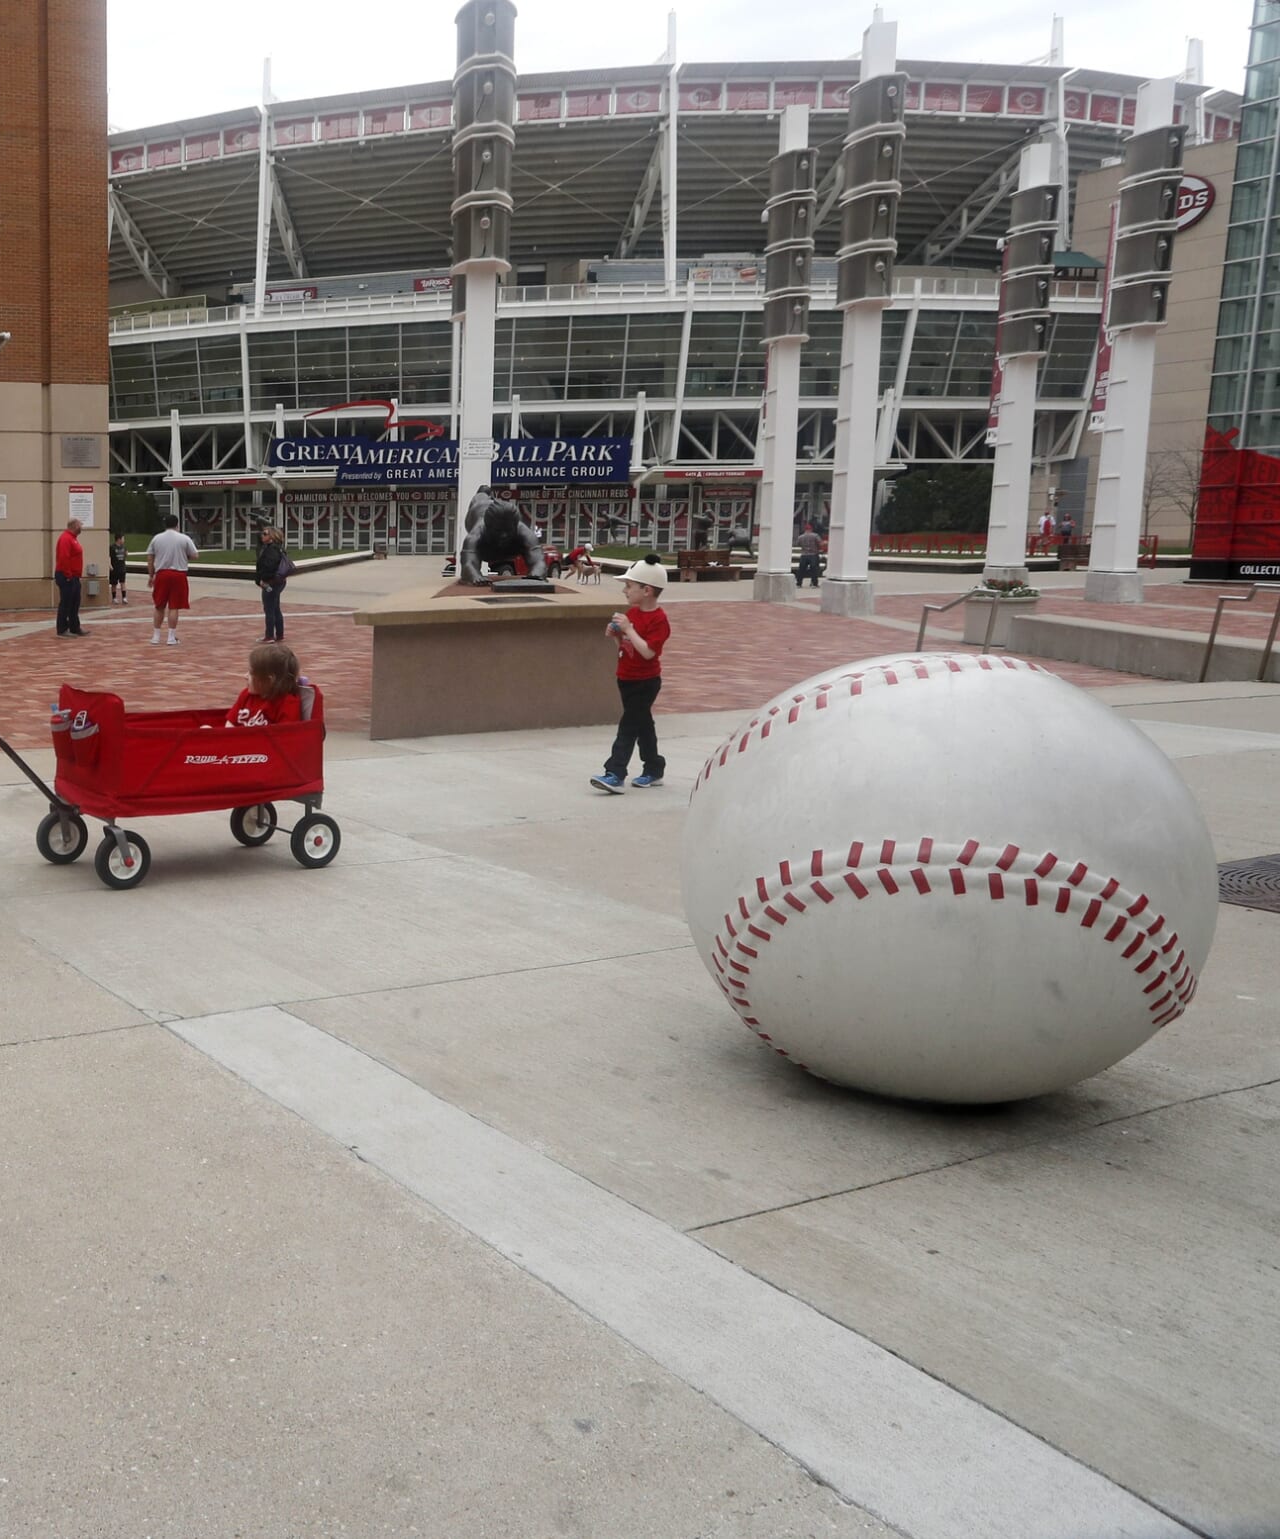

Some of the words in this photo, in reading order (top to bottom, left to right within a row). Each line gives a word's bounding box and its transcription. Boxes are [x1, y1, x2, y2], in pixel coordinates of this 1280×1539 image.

[1178, 190, 1209, 210] DS
[276, 441, 355, 462] GREAT
[546, 440, 615, 462] PARK
[341, 472, 373, 480] Presented
[373, 472, 382, 481] by
[386, 468, 424, 479] GREAT
[428, 468, 460, 479] AMER
[496, 467, 566, 477] INSURANCE
[571, 466, 614, 477] GROUP
[294, 493, 327, 502] HAMILTON
[329, 493, 354, 501] COUNTY
[357, 492, 393, 501] WELCOMES
[396, 492, 410, 500] YOU
[520, 490, 540, 499] HOME
[542, 490, 550, 499] OF
[553, 490, 566, 498] THE
[568, 489, 609, 498] CINCINNATI
[610, 489, 629, 498] REDS
